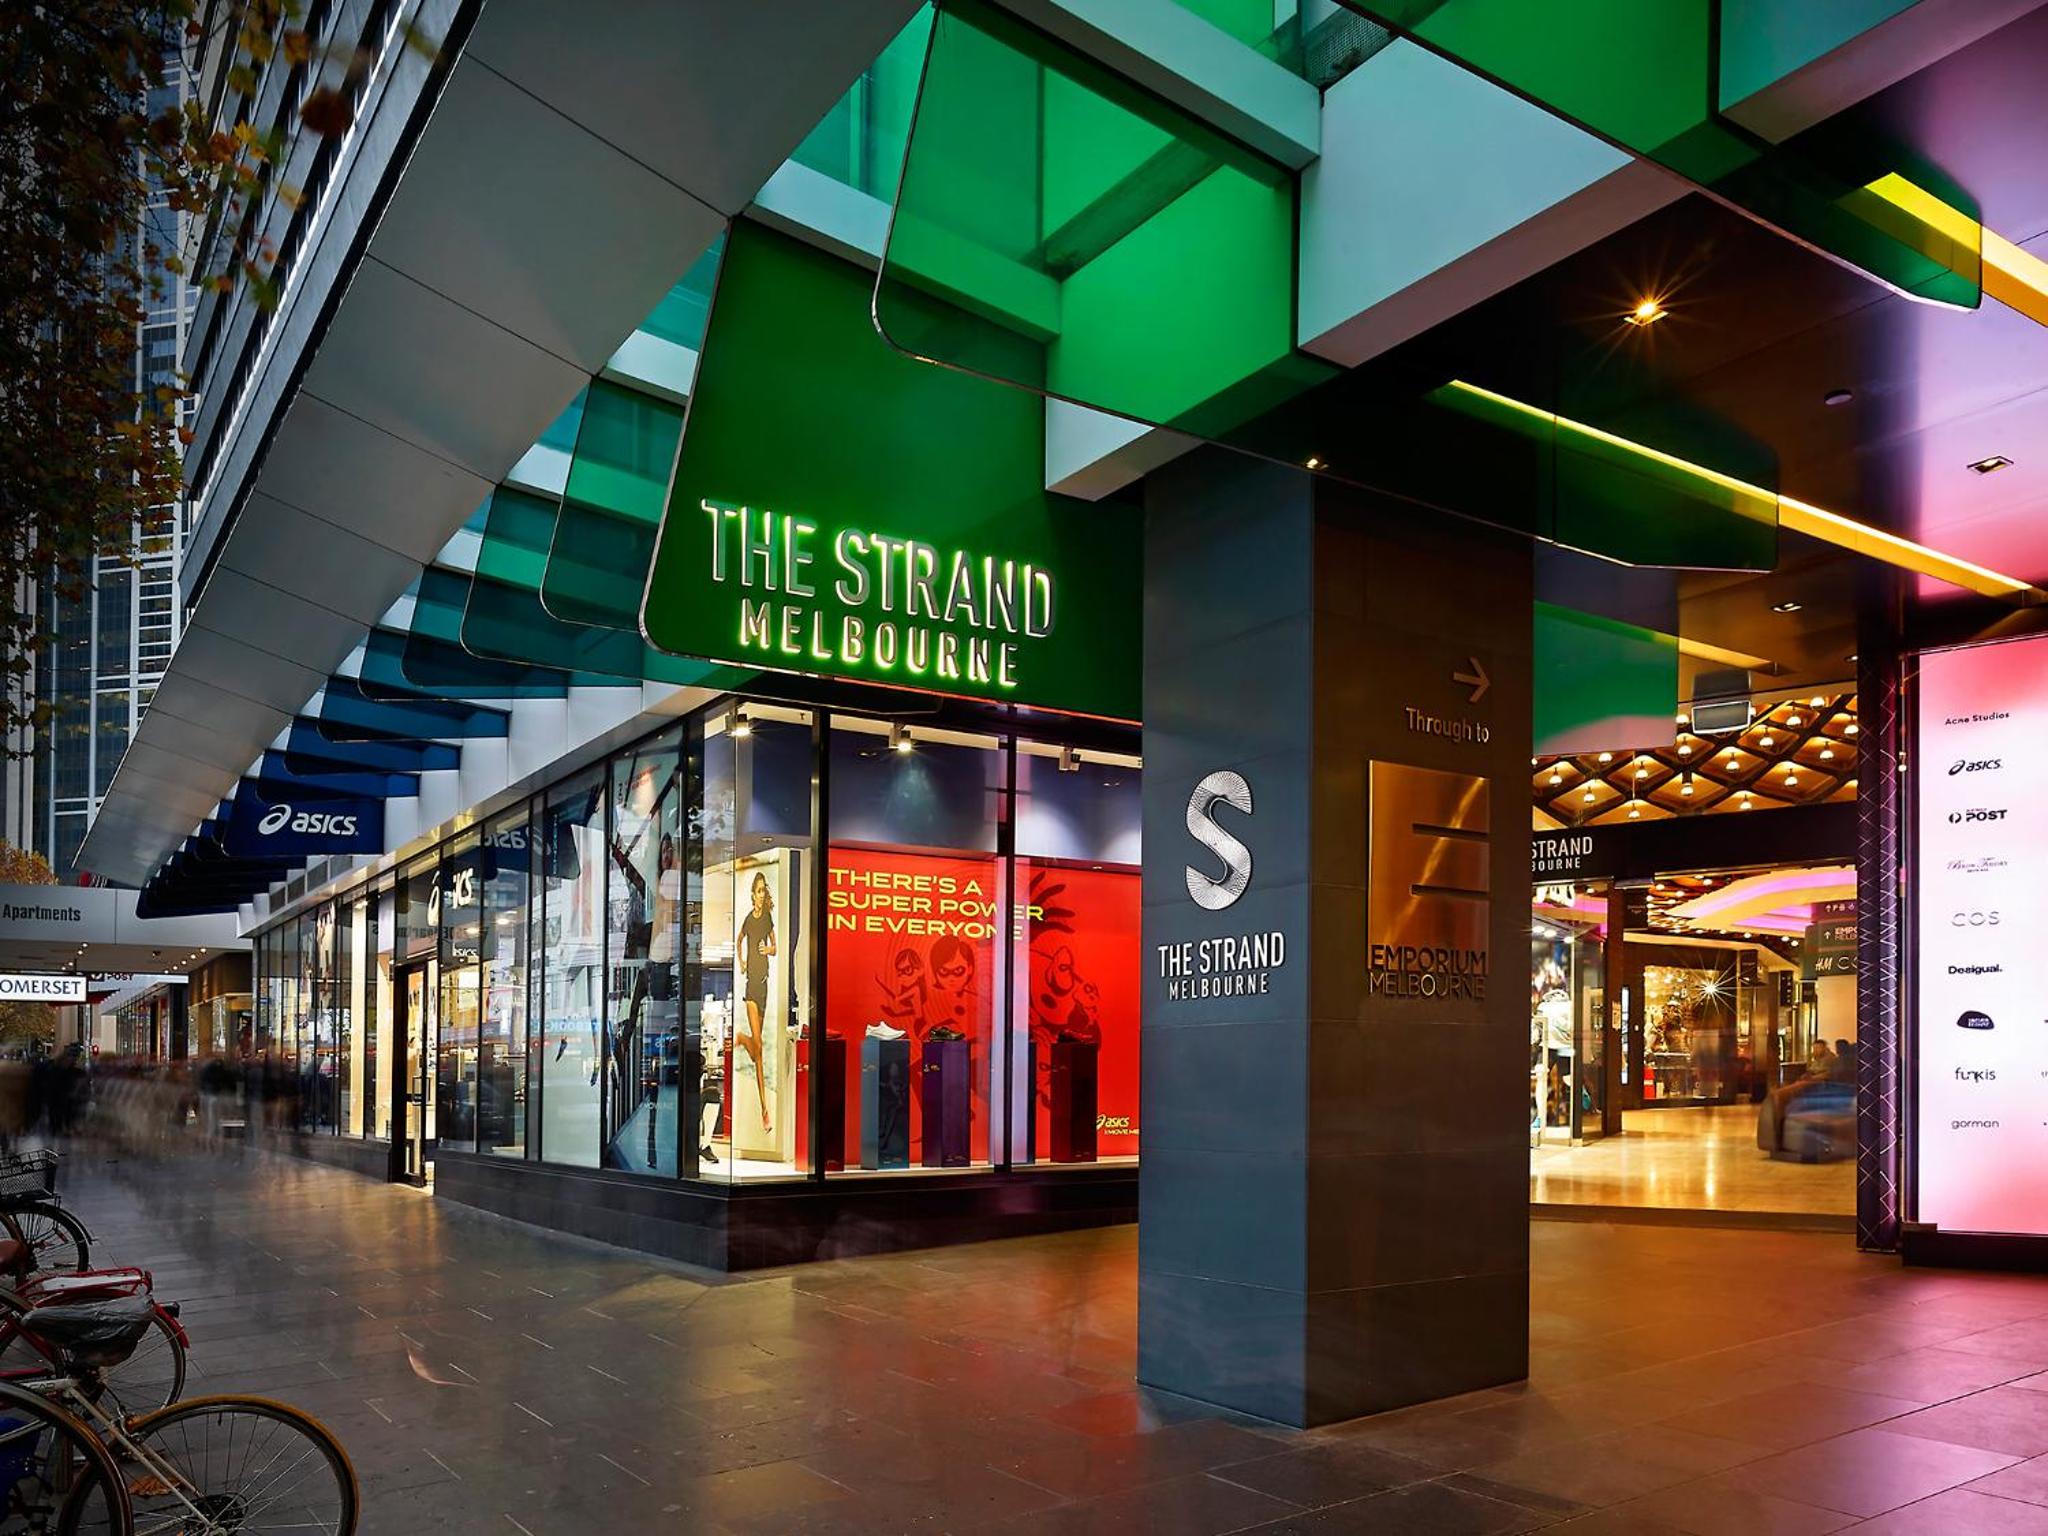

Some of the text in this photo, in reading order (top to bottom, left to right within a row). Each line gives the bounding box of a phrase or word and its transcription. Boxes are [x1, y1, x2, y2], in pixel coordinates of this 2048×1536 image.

[701, 499, 1055, 638] THE STRAND
[739, 598, 1018, 687] MELBOURNE
[1405, 706, 1490, 743] Through to
[1945, 712, 2010, 725] Acne Studios
[1966, 809, 2008, 822] POST
[1532, 836, 1593, 859] STRAND
[829, 869, 983, 896] THERE'S A
[3, 904, 81, 922] Apartments
[828, 891, 931, 914] SUPER
[828, 914, 857, 931] IN
[1952, 911, 2000, 927] COS
[1158, 931, 1285, 977] THE STRAND
[1370, 944, 1488, 976] EMPORIUM
[0, 979, 81, 995] OMERSET
[1169, 972, 1269, 1001] MELBOURNE
[1369, 971, 1487, 999] MELBOURNE
[1951, 1119, 2000, 1130] gorman
